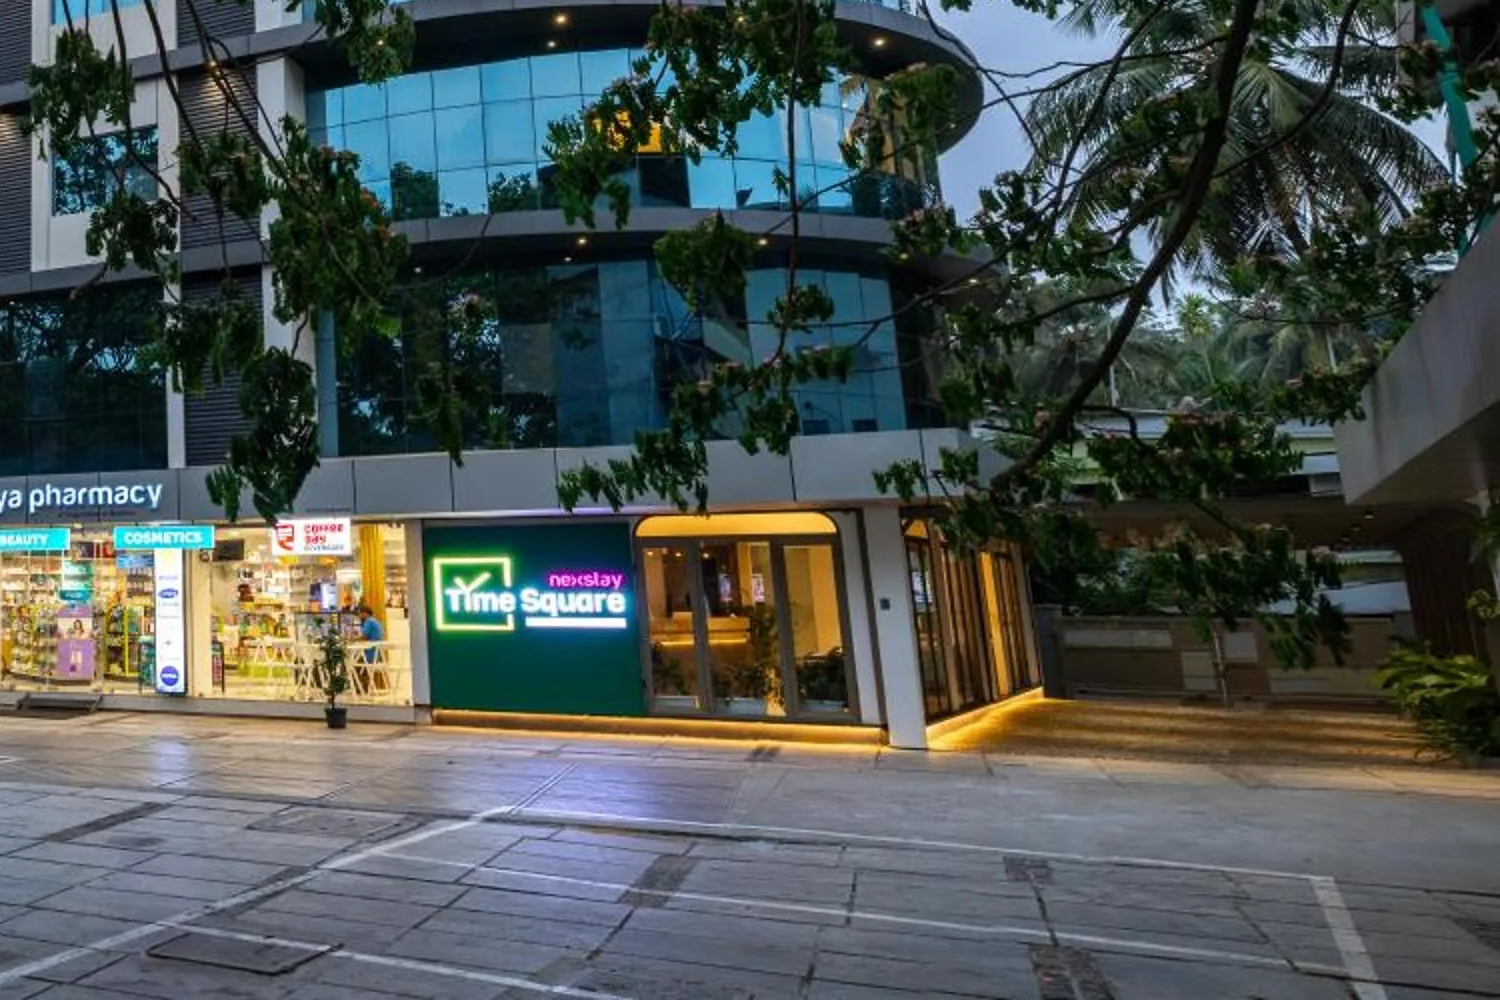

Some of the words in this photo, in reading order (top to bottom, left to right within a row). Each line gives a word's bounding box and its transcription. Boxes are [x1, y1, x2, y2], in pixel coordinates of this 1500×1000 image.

[29, 483, 164, 514] pharmacy
[123, 531, 203, 545] COSMETICS
[548, 571, 623, 590] nexstay
[444, 588, 517, 614] Time
[519, 587, 627, 617] Square
